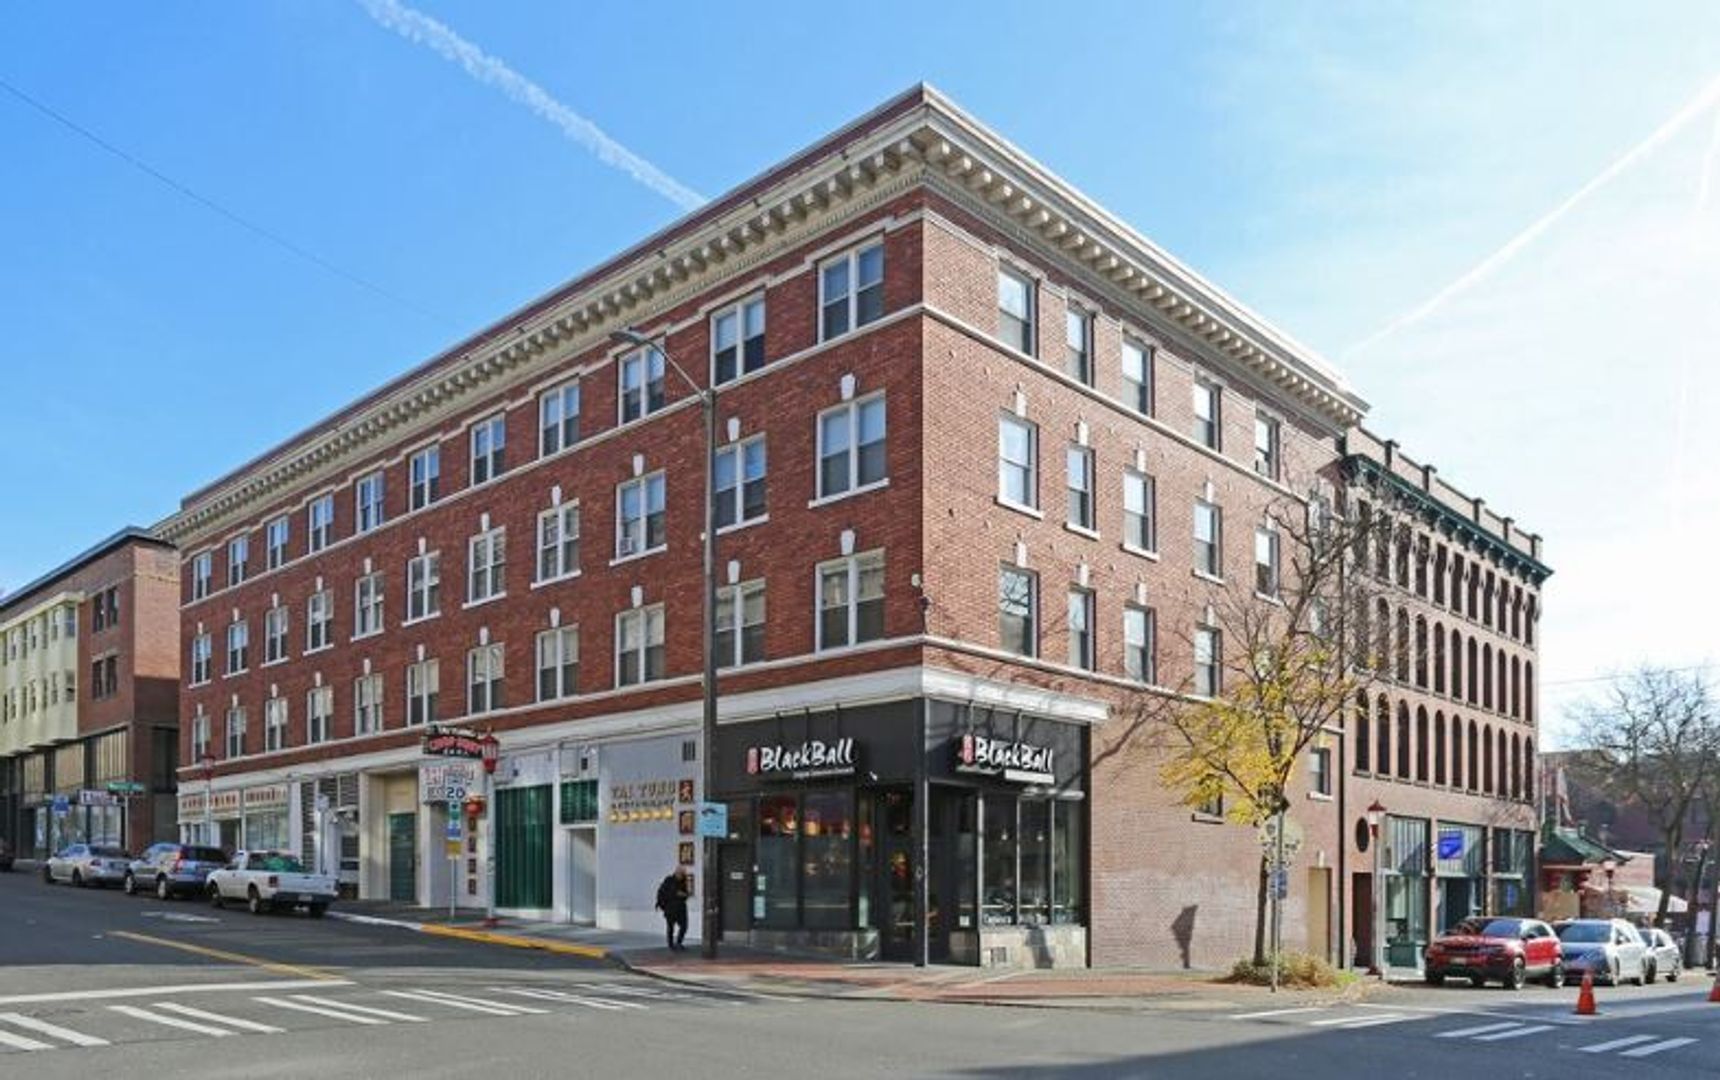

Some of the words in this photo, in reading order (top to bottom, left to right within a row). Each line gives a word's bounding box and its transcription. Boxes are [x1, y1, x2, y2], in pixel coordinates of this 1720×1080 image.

[760, 738, 854, 771] BlackBall
[975, 736, 1053, 773] BlackBall
[446, 786, 466, 799] 20
